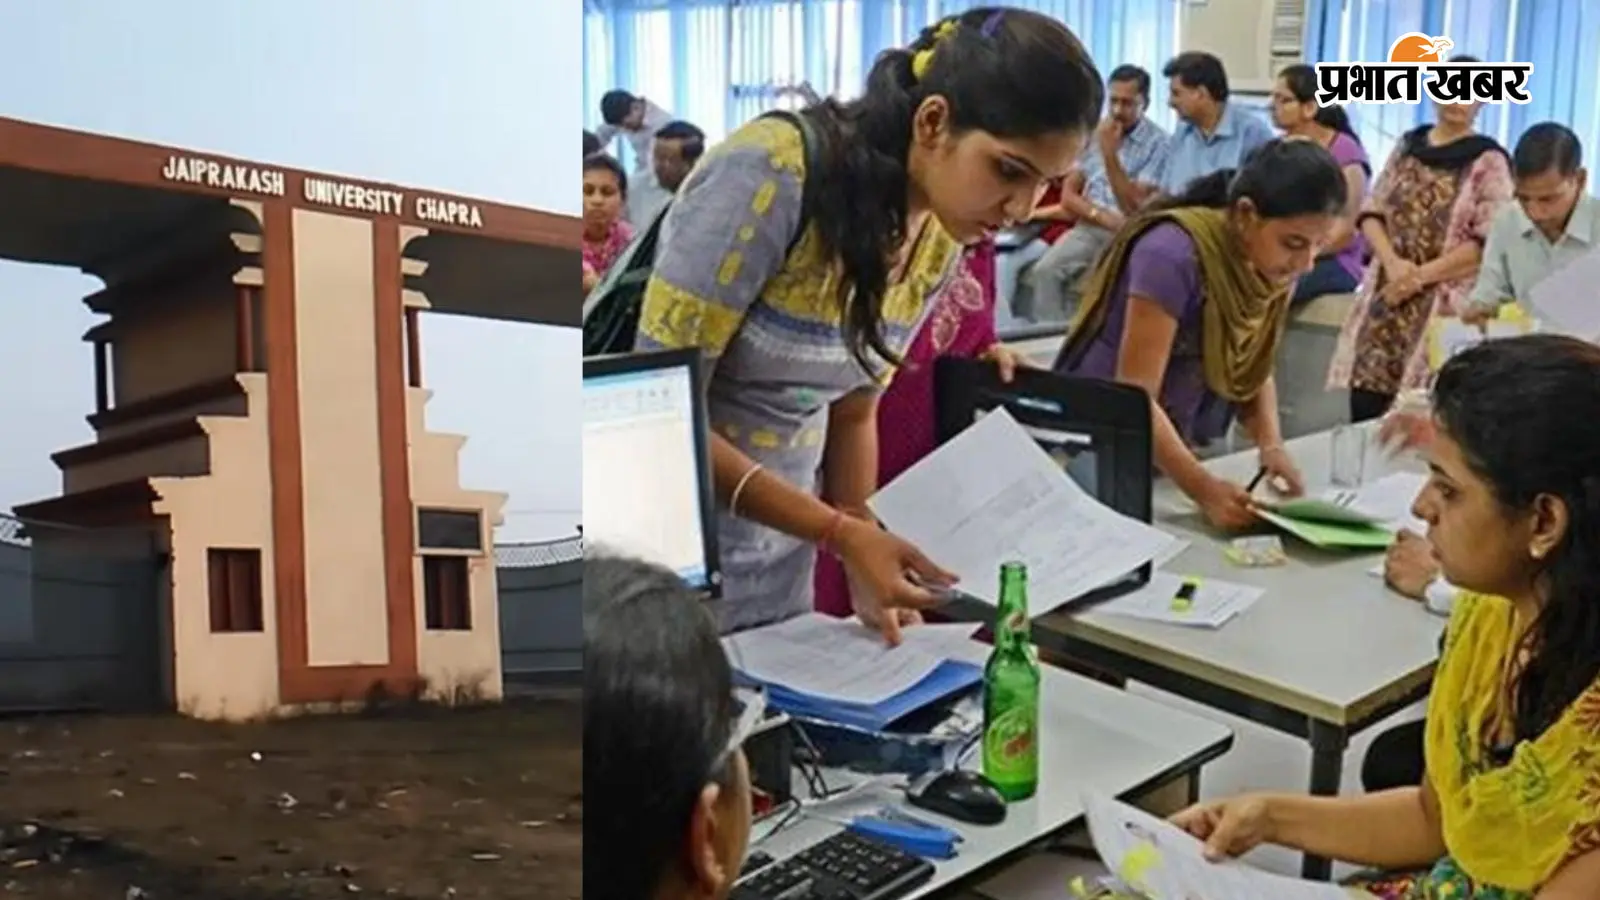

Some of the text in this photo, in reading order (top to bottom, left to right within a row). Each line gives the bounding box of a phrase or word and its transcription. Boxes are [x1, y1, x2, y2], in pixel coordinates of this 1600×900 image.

[163, 156, 483, 227] JAIPRAKASH UNIVERSITY CHAPRA
